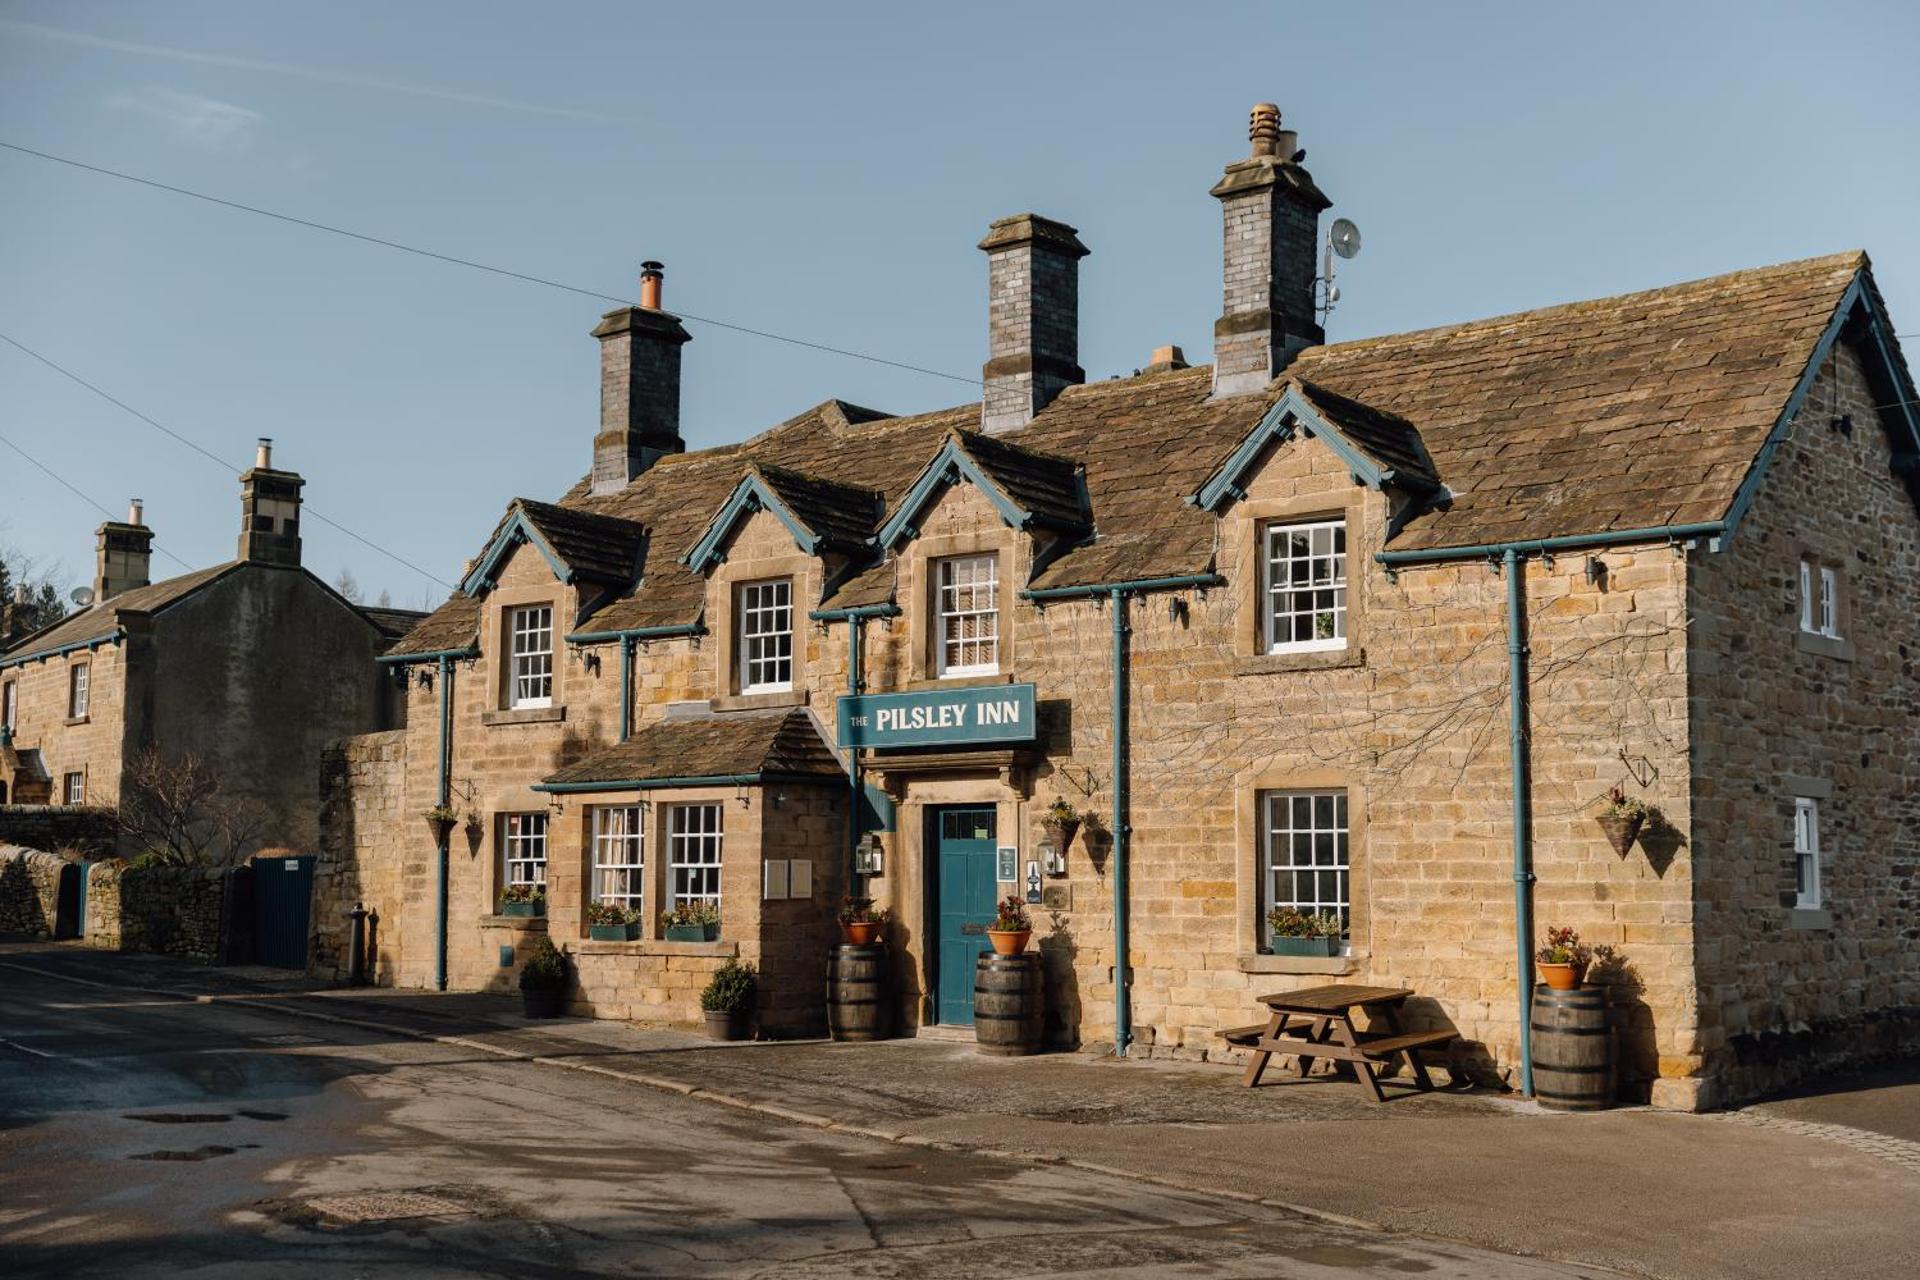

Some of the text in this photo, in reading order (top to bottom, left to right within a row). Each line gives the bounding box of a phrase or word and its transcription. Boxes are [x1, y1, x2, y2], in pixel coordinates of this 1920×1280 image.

[850, 700, 1019, 731] THE PILSLEY INN
